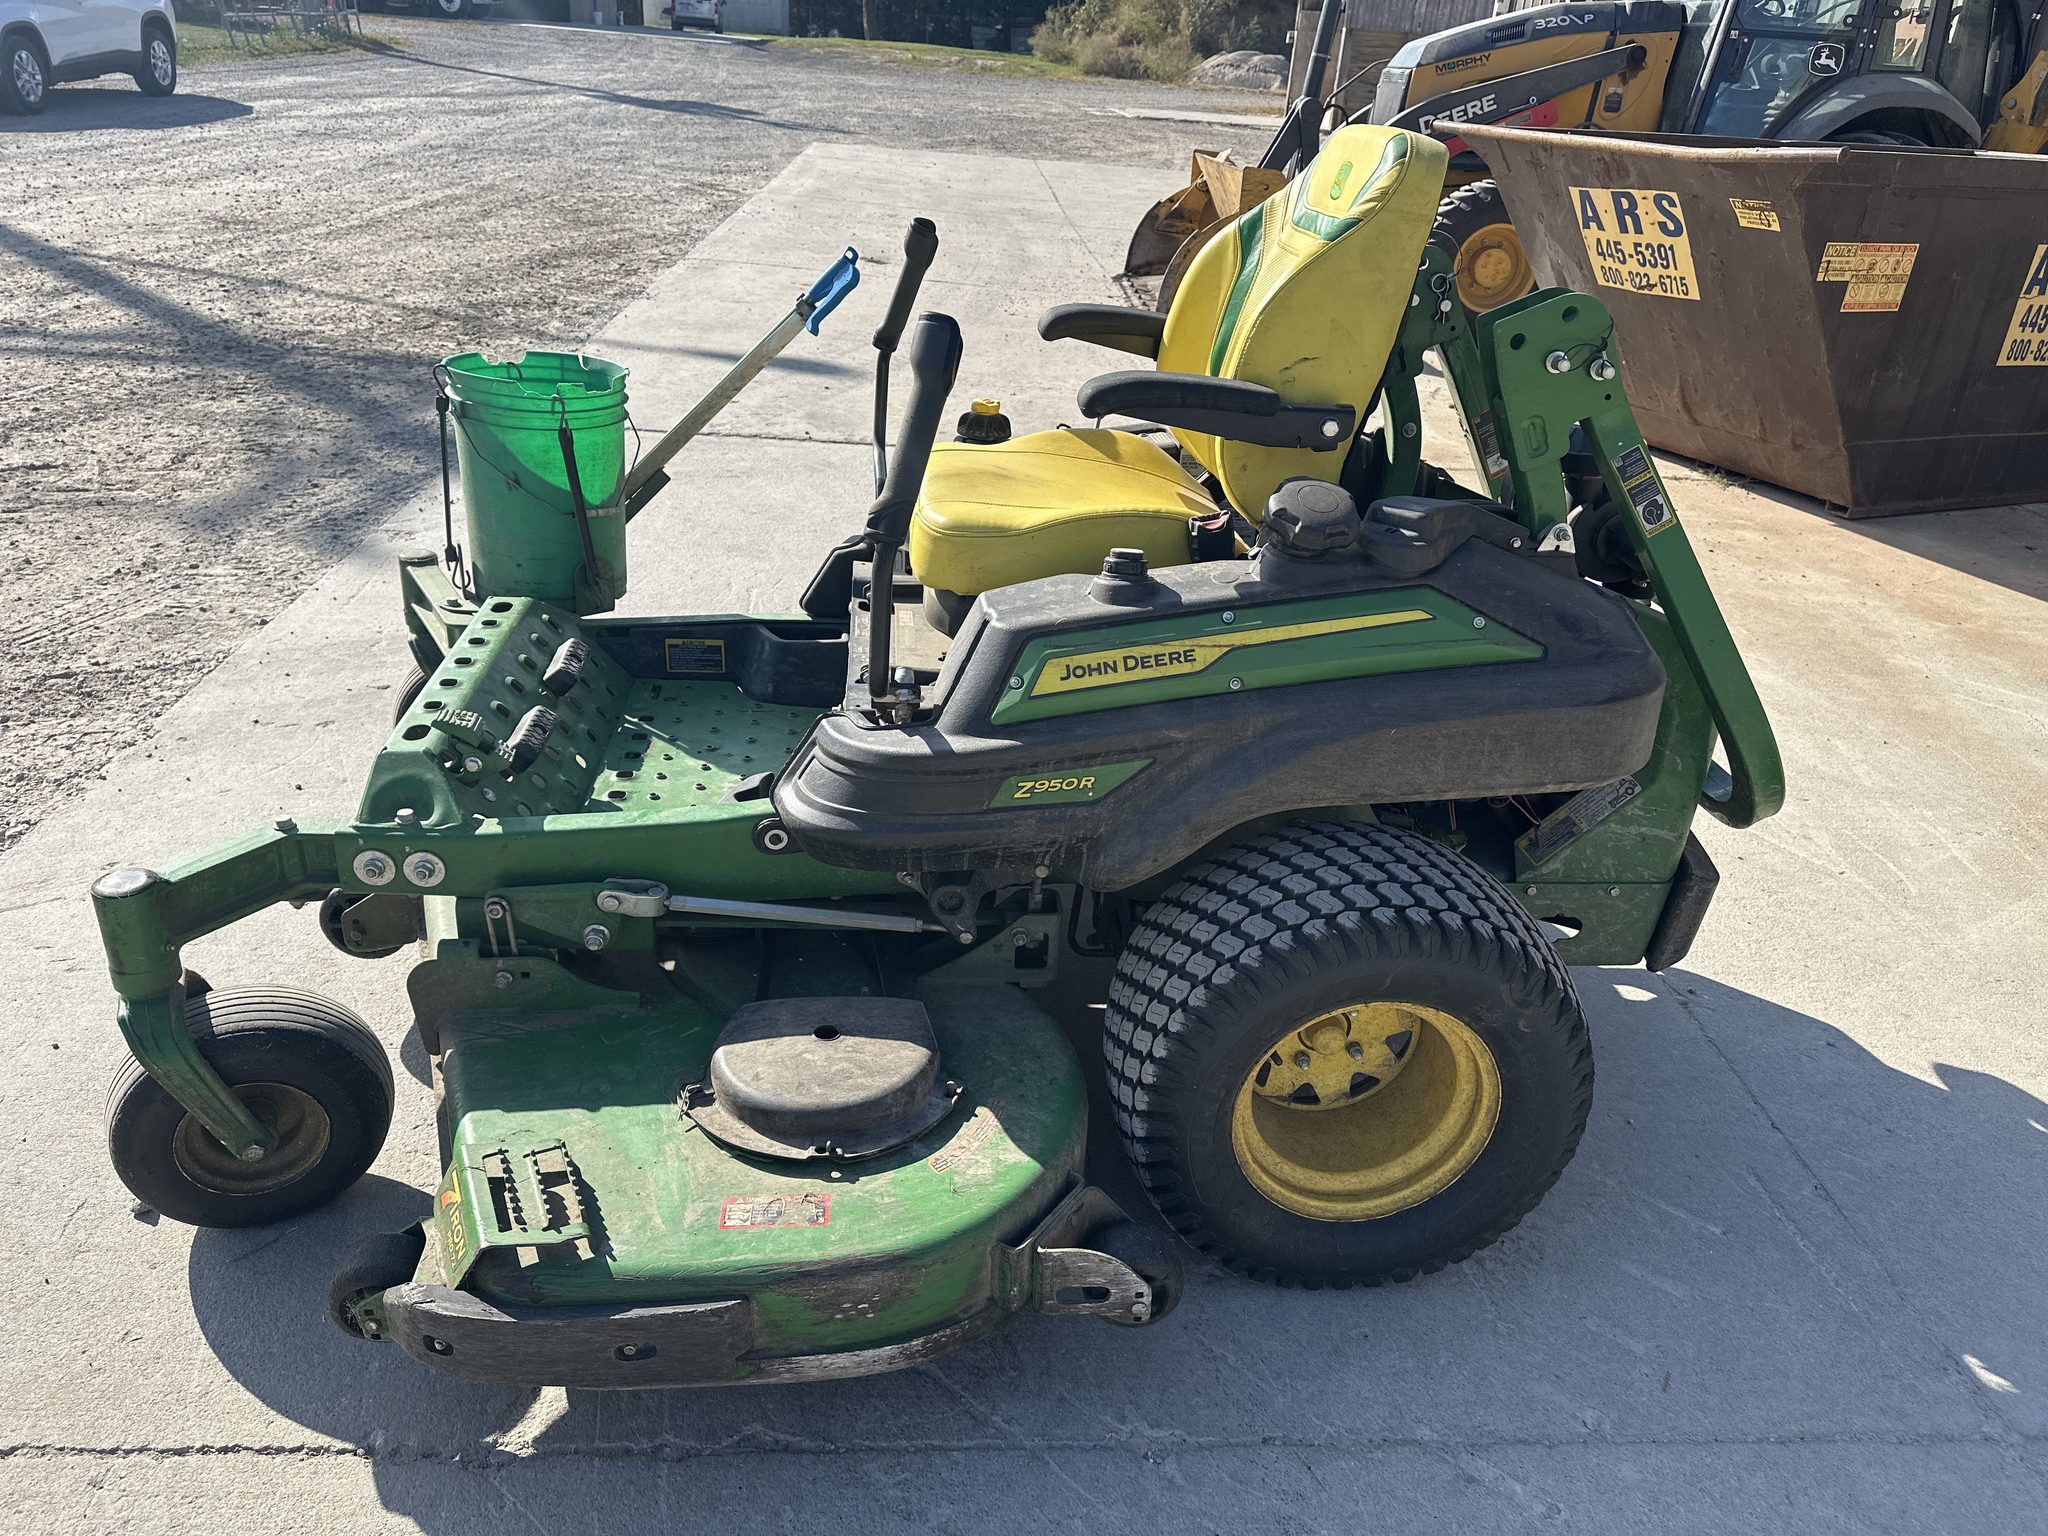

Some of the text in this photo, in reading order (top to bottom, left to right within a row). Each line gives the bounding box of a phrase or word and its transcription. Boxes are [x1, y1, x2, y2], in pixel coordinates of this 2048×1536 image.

[1435, 53, 1491, 73] MURPHY
[1418, 94, 1498, 134] DEERE
[1596, 238, 1678, 270] 445-5391
[1827, 245, 1858, 256] NOTICE
[1856, 275, 1878, 283] CAUTION
[1885, 275, 1907, 283] CAUTION
[1060, 649, 1196, 681] JOHN DEERE
[1014, 776, 1095, 798] Z950R
